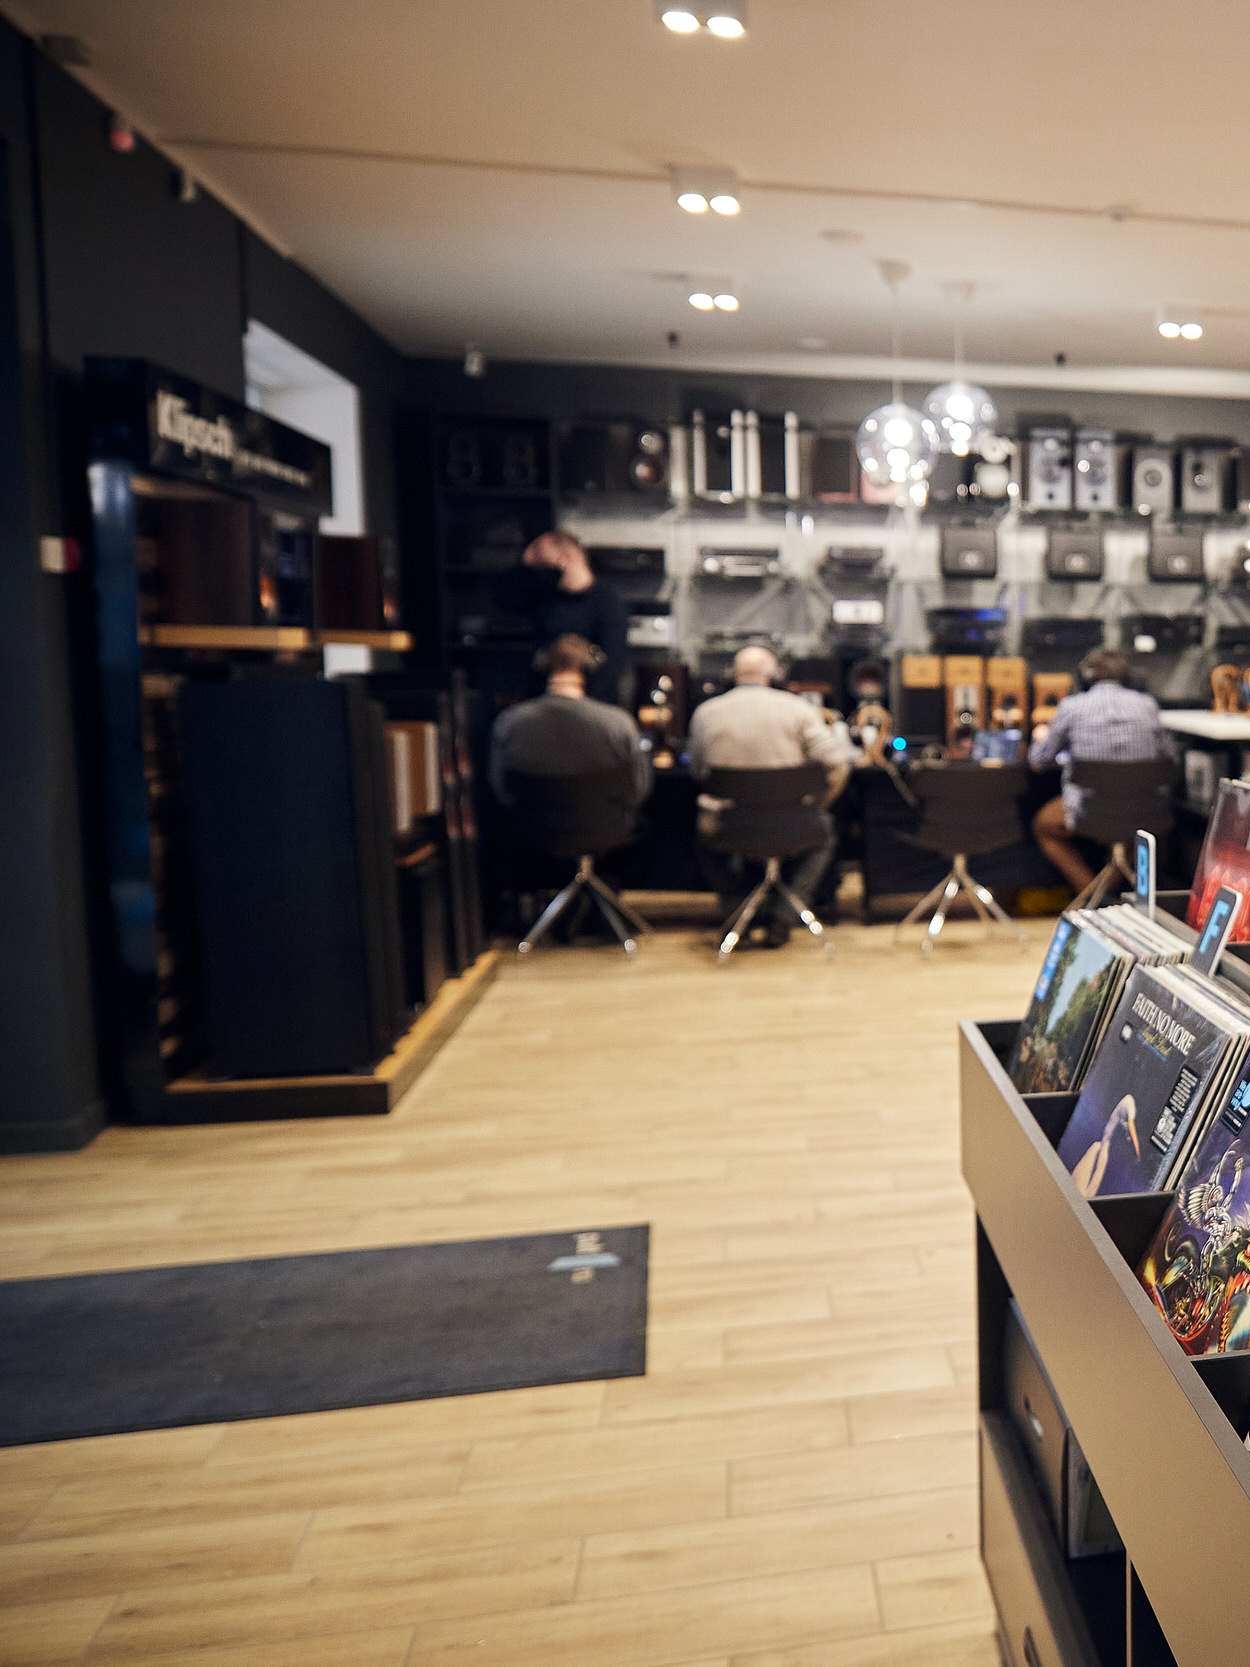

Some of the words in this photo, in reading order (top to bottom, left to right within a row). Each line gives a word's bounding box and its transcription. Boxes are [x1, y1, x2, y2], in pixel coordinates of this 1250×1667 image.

[1137, 845, 1150, 897] B
[1199, 900, 1230, 953] F
[1132, 992, 1160, 1024] FAITH
[1152, 1009, 1172, 1034] NO
[1165, 1020, 1196, 1056] MORE
